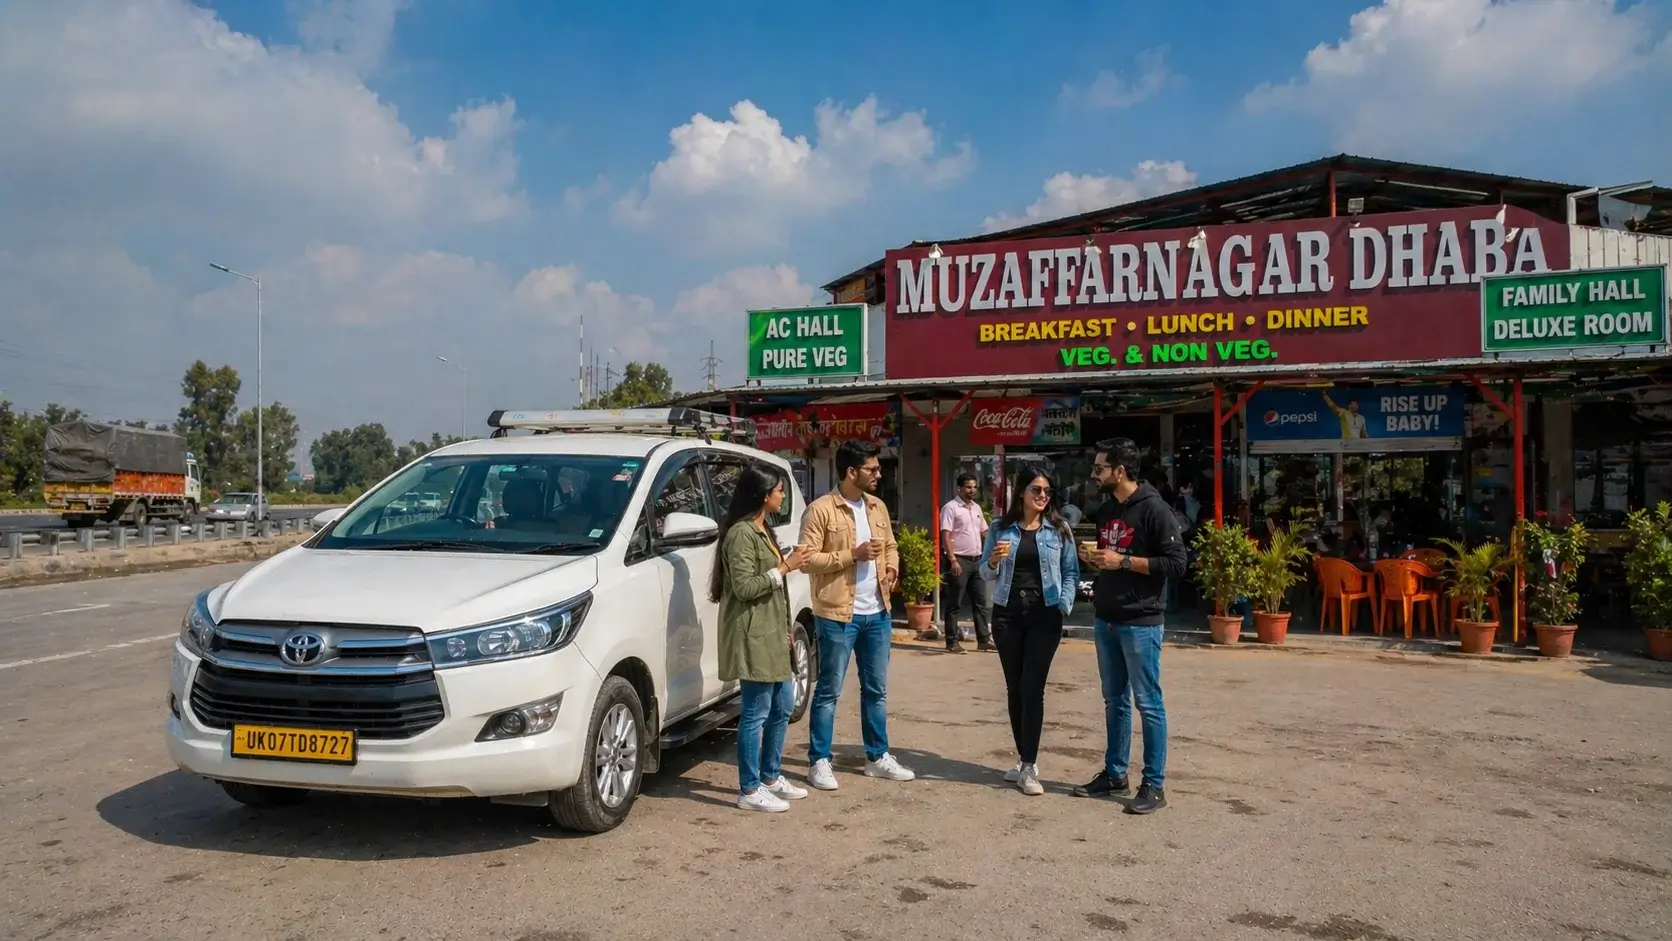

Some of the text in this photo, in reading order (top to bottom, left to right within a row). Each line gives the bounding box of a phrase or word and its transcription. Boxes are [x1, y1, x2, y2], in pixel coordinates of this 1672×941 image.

[897, 218, 1553, 314] MUZAFFARNAGAR DHABA
[1502, 278, 1646, 307] FAMILY HALL
[766, 314, 844, 339] AC HALL
[980, 306, 1368, 342] BREAKFAST LUNCH DINNER
[1494, 311, 1653, 340] DELUXE ROOM
[762, 346, 847, 369] PURE VEG
[1060, 339, 1278, 366] VEG. & NON VEG.
[1380, 394, 1448, 413] RISE UP
[973, 406, 1034, 430] Coca-Cola
[1280, 410, 1318, 425] pepsi
[1386, 413, 1440, 432] BABY!
[246, 730, 349, 755] UK07TD8727
